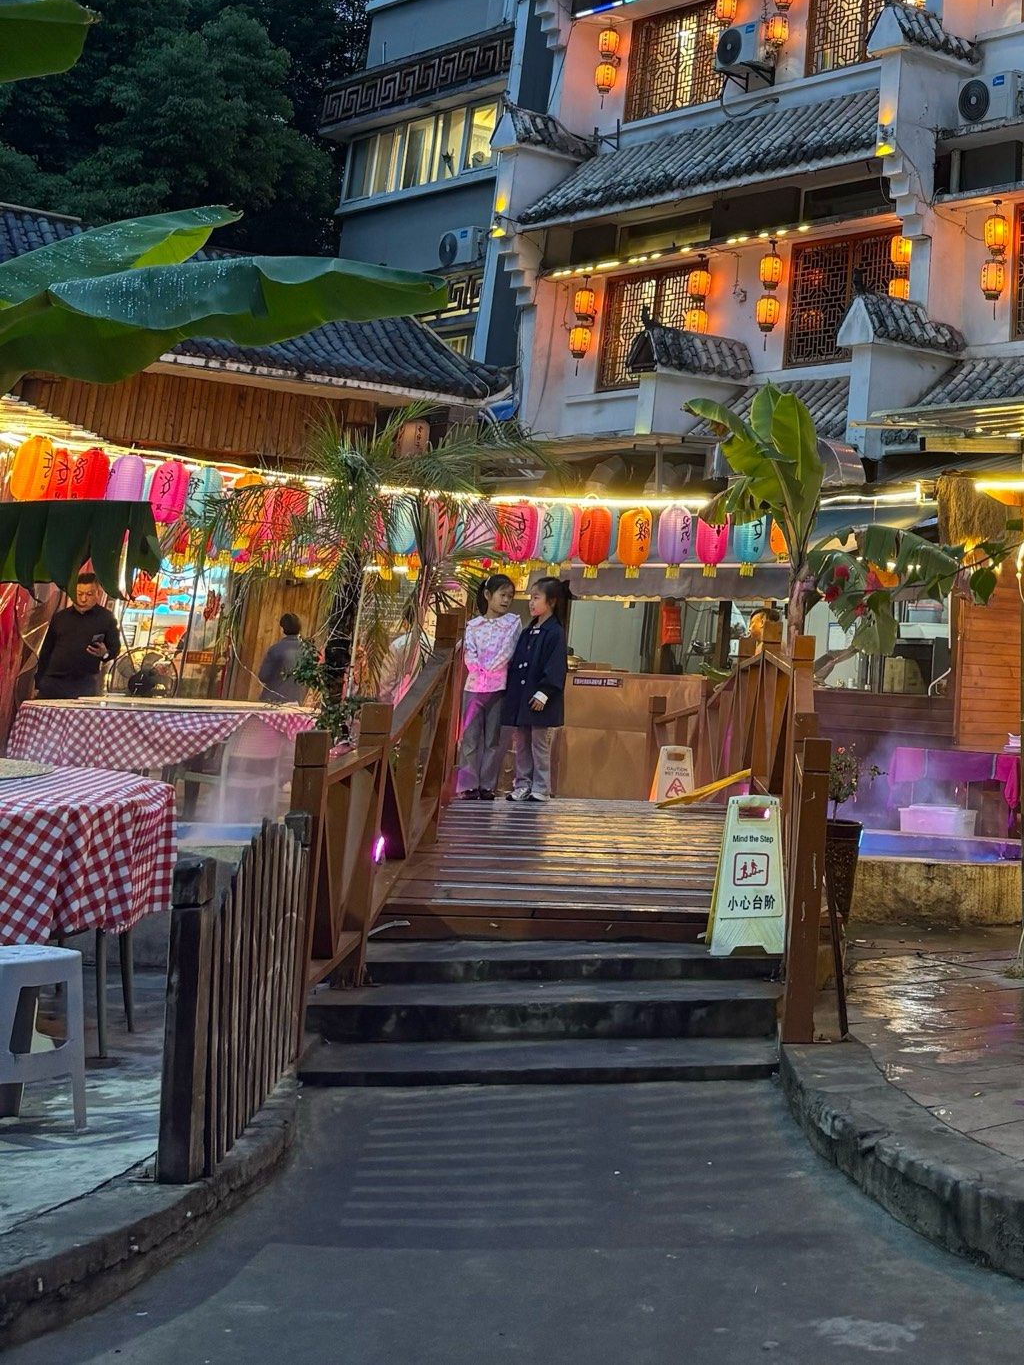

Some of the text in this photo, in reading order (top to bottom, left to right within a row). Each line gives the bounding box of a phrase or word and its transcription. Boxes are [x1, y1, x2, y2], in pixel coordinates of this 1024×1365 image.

[732, 835, 774, 844] Mind the Step
[727, 894, 776, 911] 小心台阶
